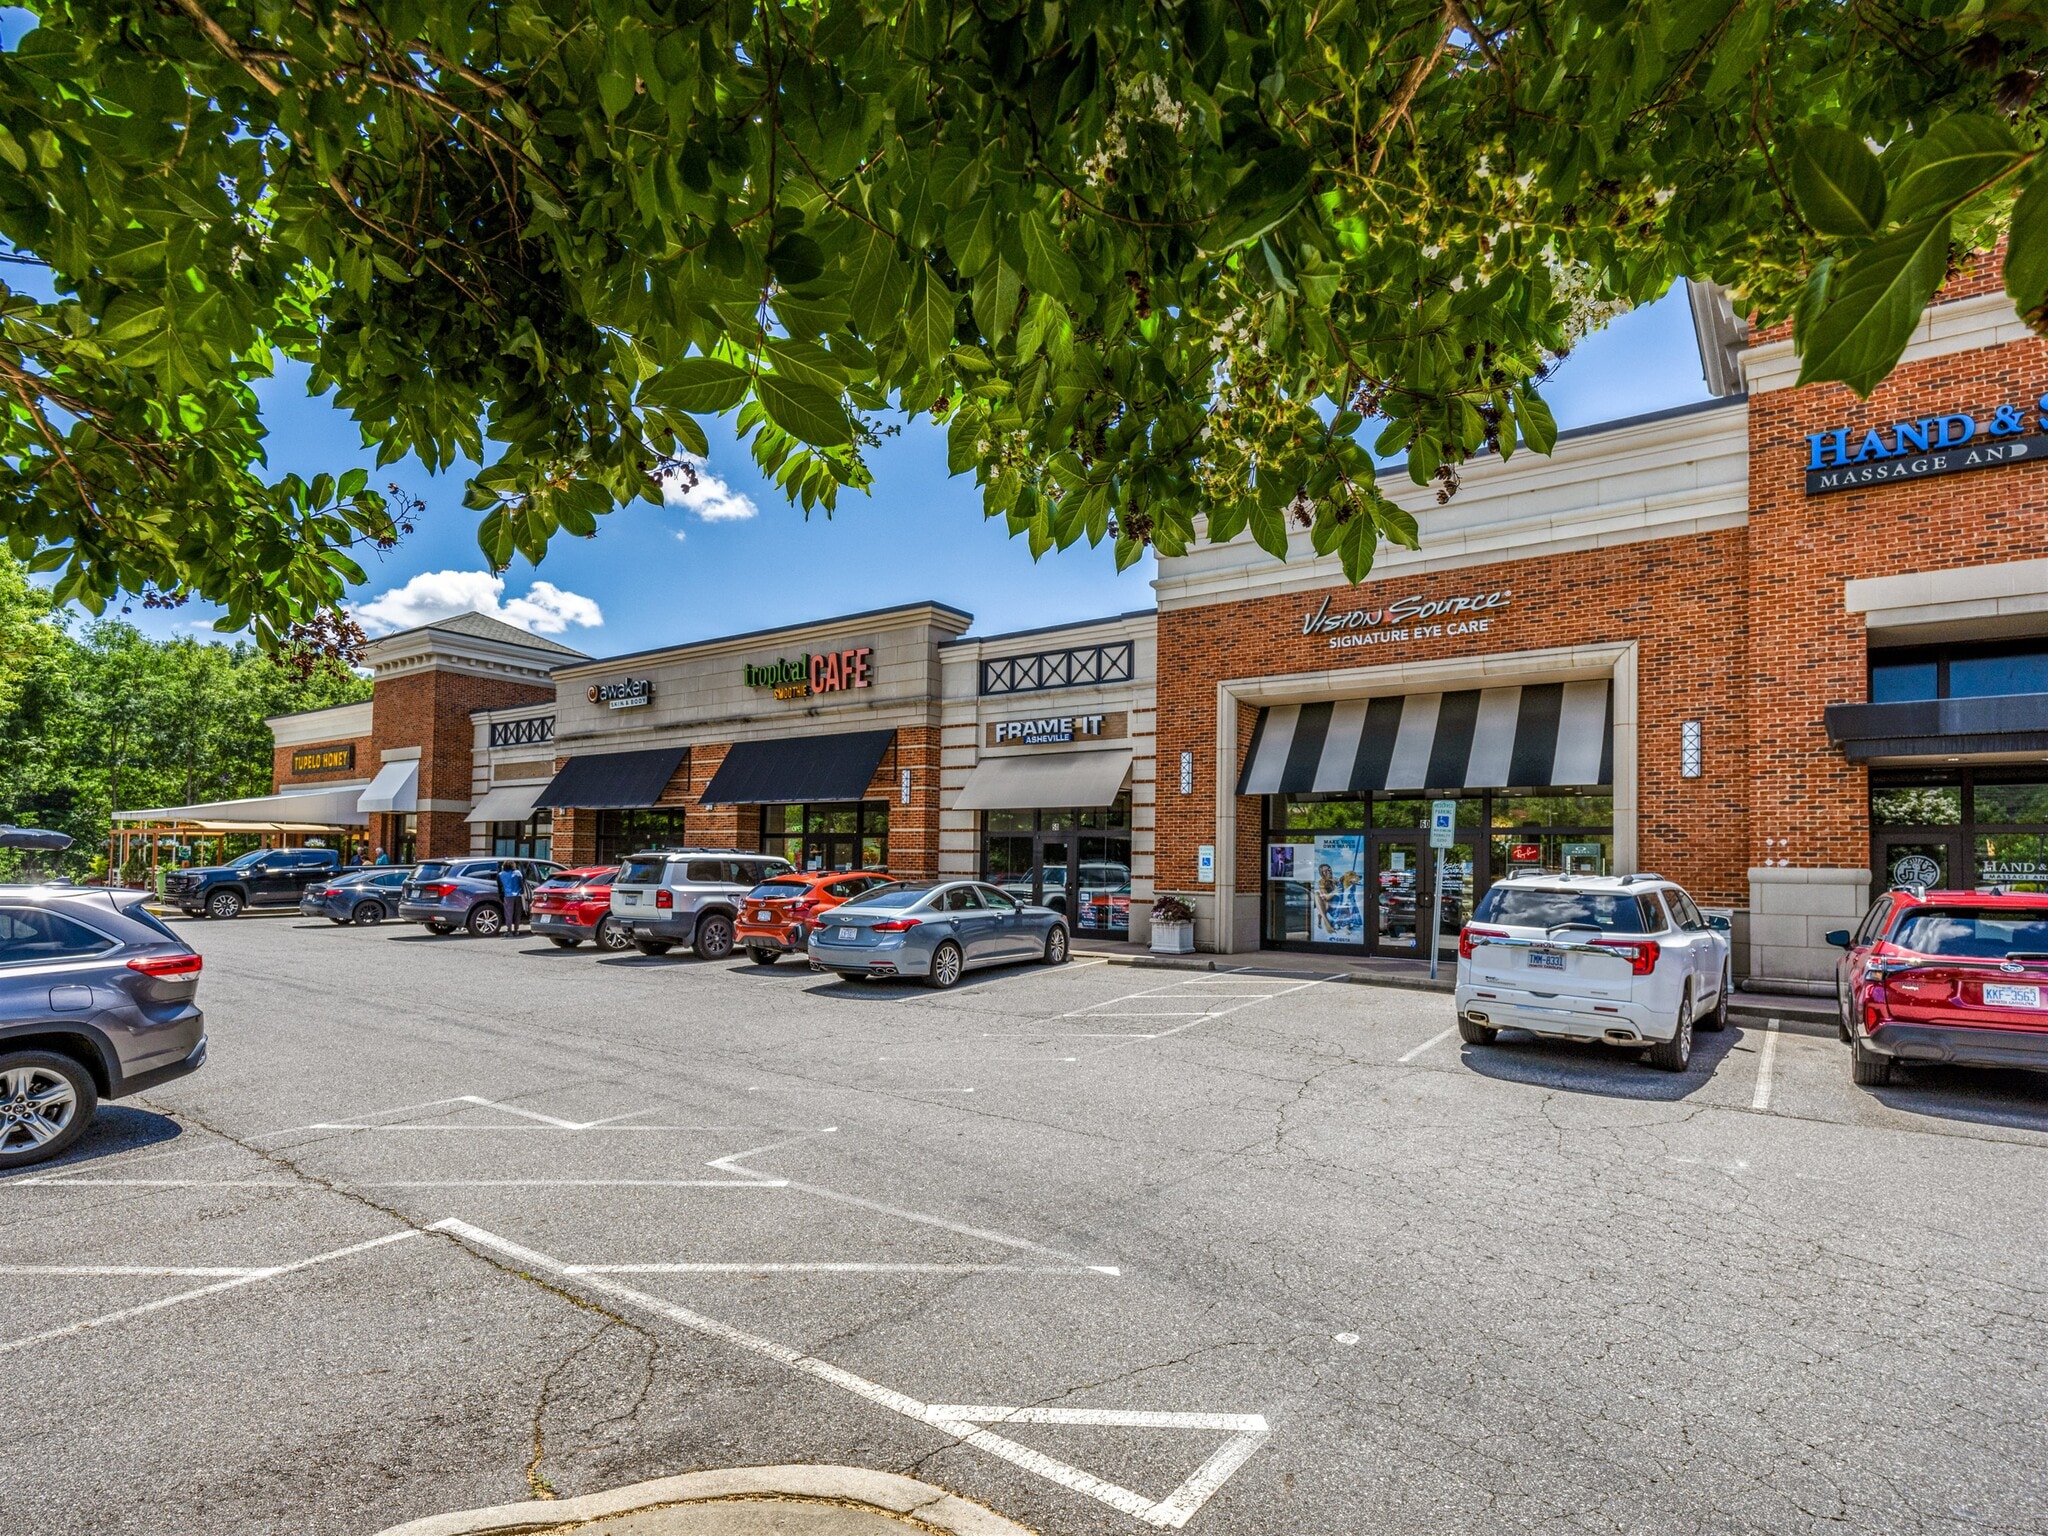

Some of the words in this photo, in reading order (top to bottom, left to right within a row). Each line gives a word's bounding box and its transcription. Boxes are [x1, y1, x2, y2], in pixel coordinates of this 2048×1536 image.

[1805, 412, 1977, 471] HAND
[1989, 404, 2025, 436] &
[1820, 456, 1948, 489] MASSAGE
[1964, 443, 2028, 466] AND
[1329, 628, 1409, 649] SIGNATURE
[1414, 624, 1442, 640] EYE
[1447, 618, 1489, 636] CARE
[743, 652, 808, 689] tropical
[810, 647, 870, 694] CAFE
[600, 676, 649, 701] awaken
[773, 684, 807, 700] SMOOTHIE
[610, 700, 625, 708] SKIN
[995, 717, 1074, 743] FRAME
[1082, 715, 1104, 736] IT
[1025, 733, 1070, 744] ASHEVILLE
[294, 754, 321, 771] TUPELO
[322, 750, 349, 768] HONEY
[1420, 820, 1430, 828] 60
[1983, 860, 2036, 873] HAND
[2038, 862, 2048, 871] &
[1985, 988, 2037, 1002] KKF-3563
